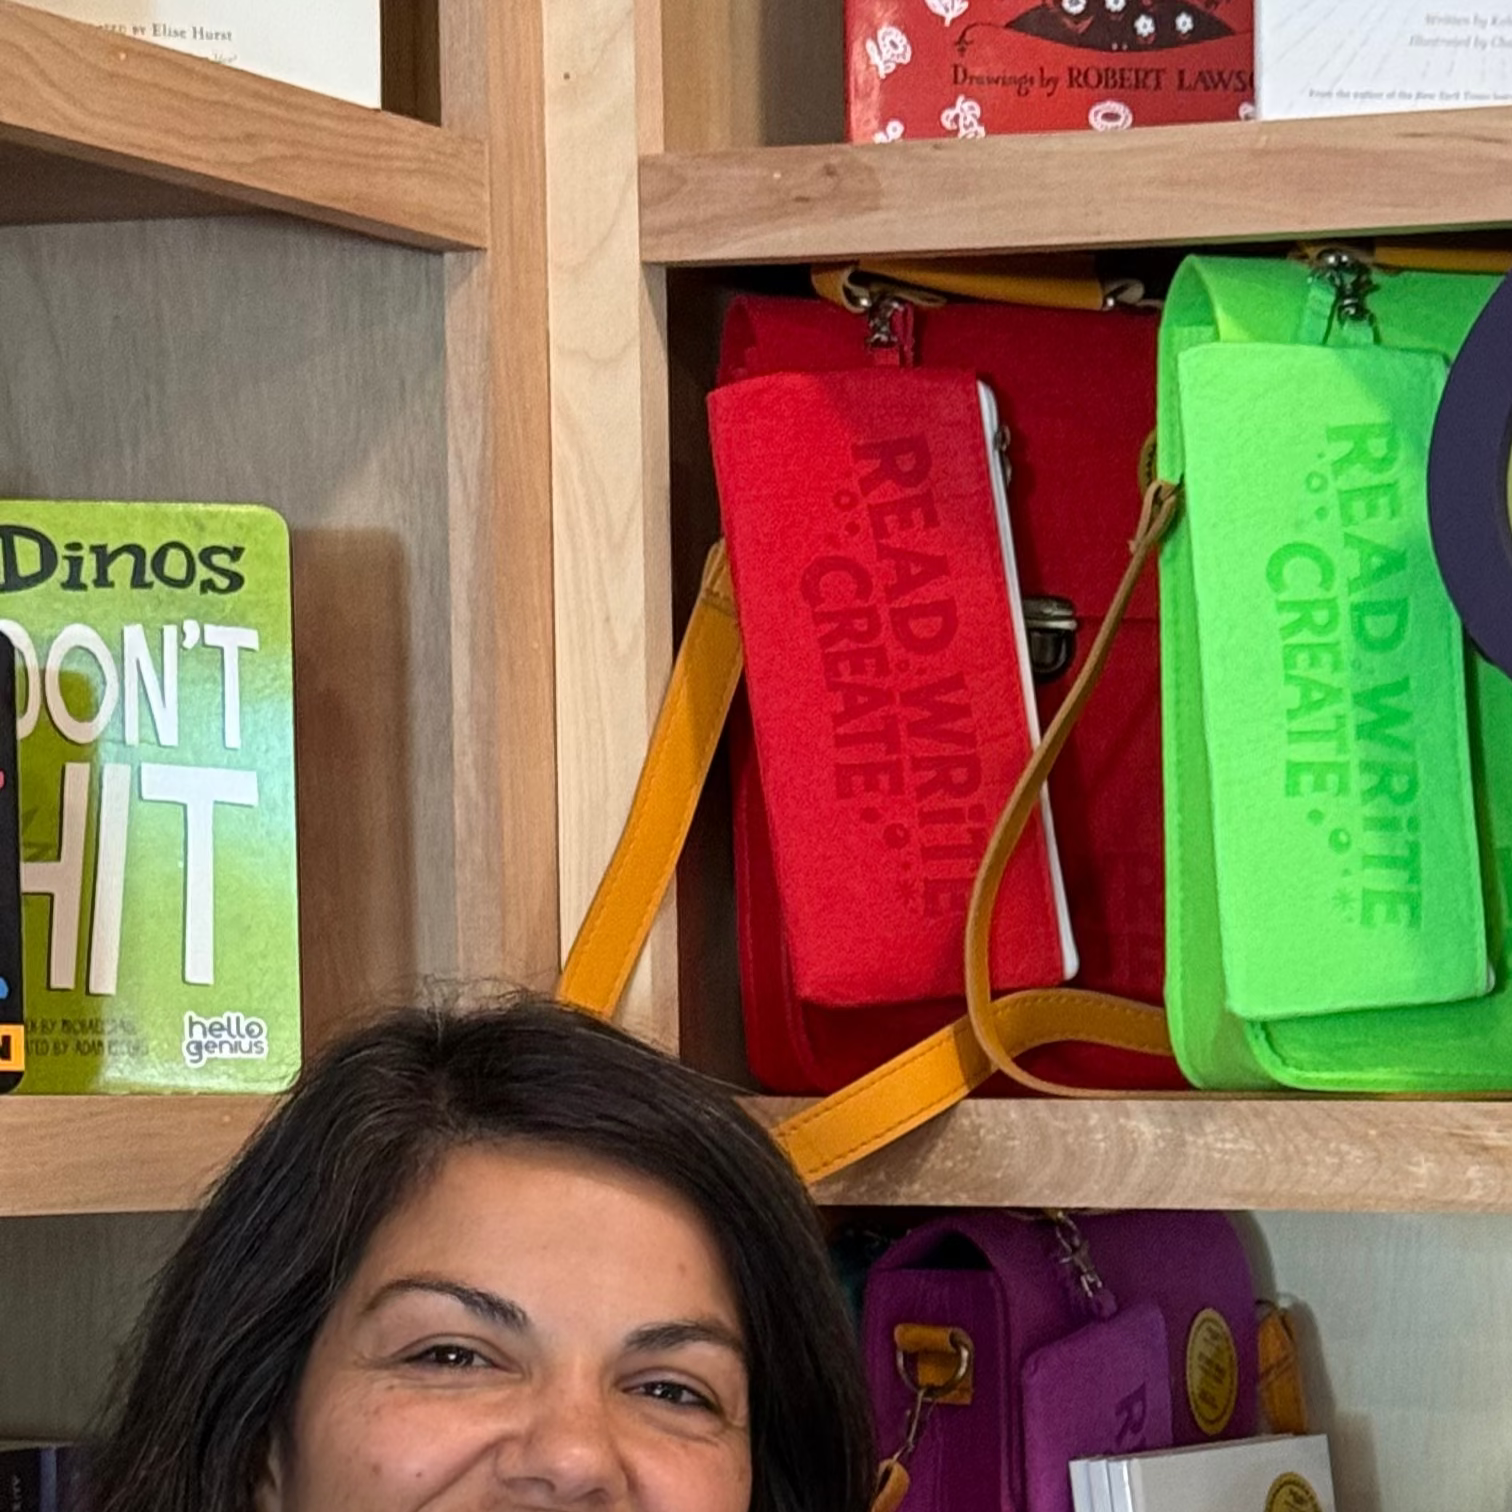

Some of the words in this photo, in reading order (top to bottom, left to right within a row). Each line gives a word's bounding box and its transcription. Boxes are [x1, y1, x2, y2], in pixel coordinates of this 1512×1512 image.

[152, 22, 187, 39] Elise
[192, 26, 232, 42] Hurst
[953, 63, 1035, 93] Drawings
[1039, 66, 1059, 95] by
[1067, 66, 1165, 91] ROBERT
[0, 523, 245, 596] Dinos
[855, 436, 961, 657] READ
[1322, 420, 1410, 658] READ
[803, 554, 904, 803] CREATE
[1265, 541, 1350, 802] CREATE
[185, 1039, 265, 1064] genius
[187, 1015, 264, 1040] hello
